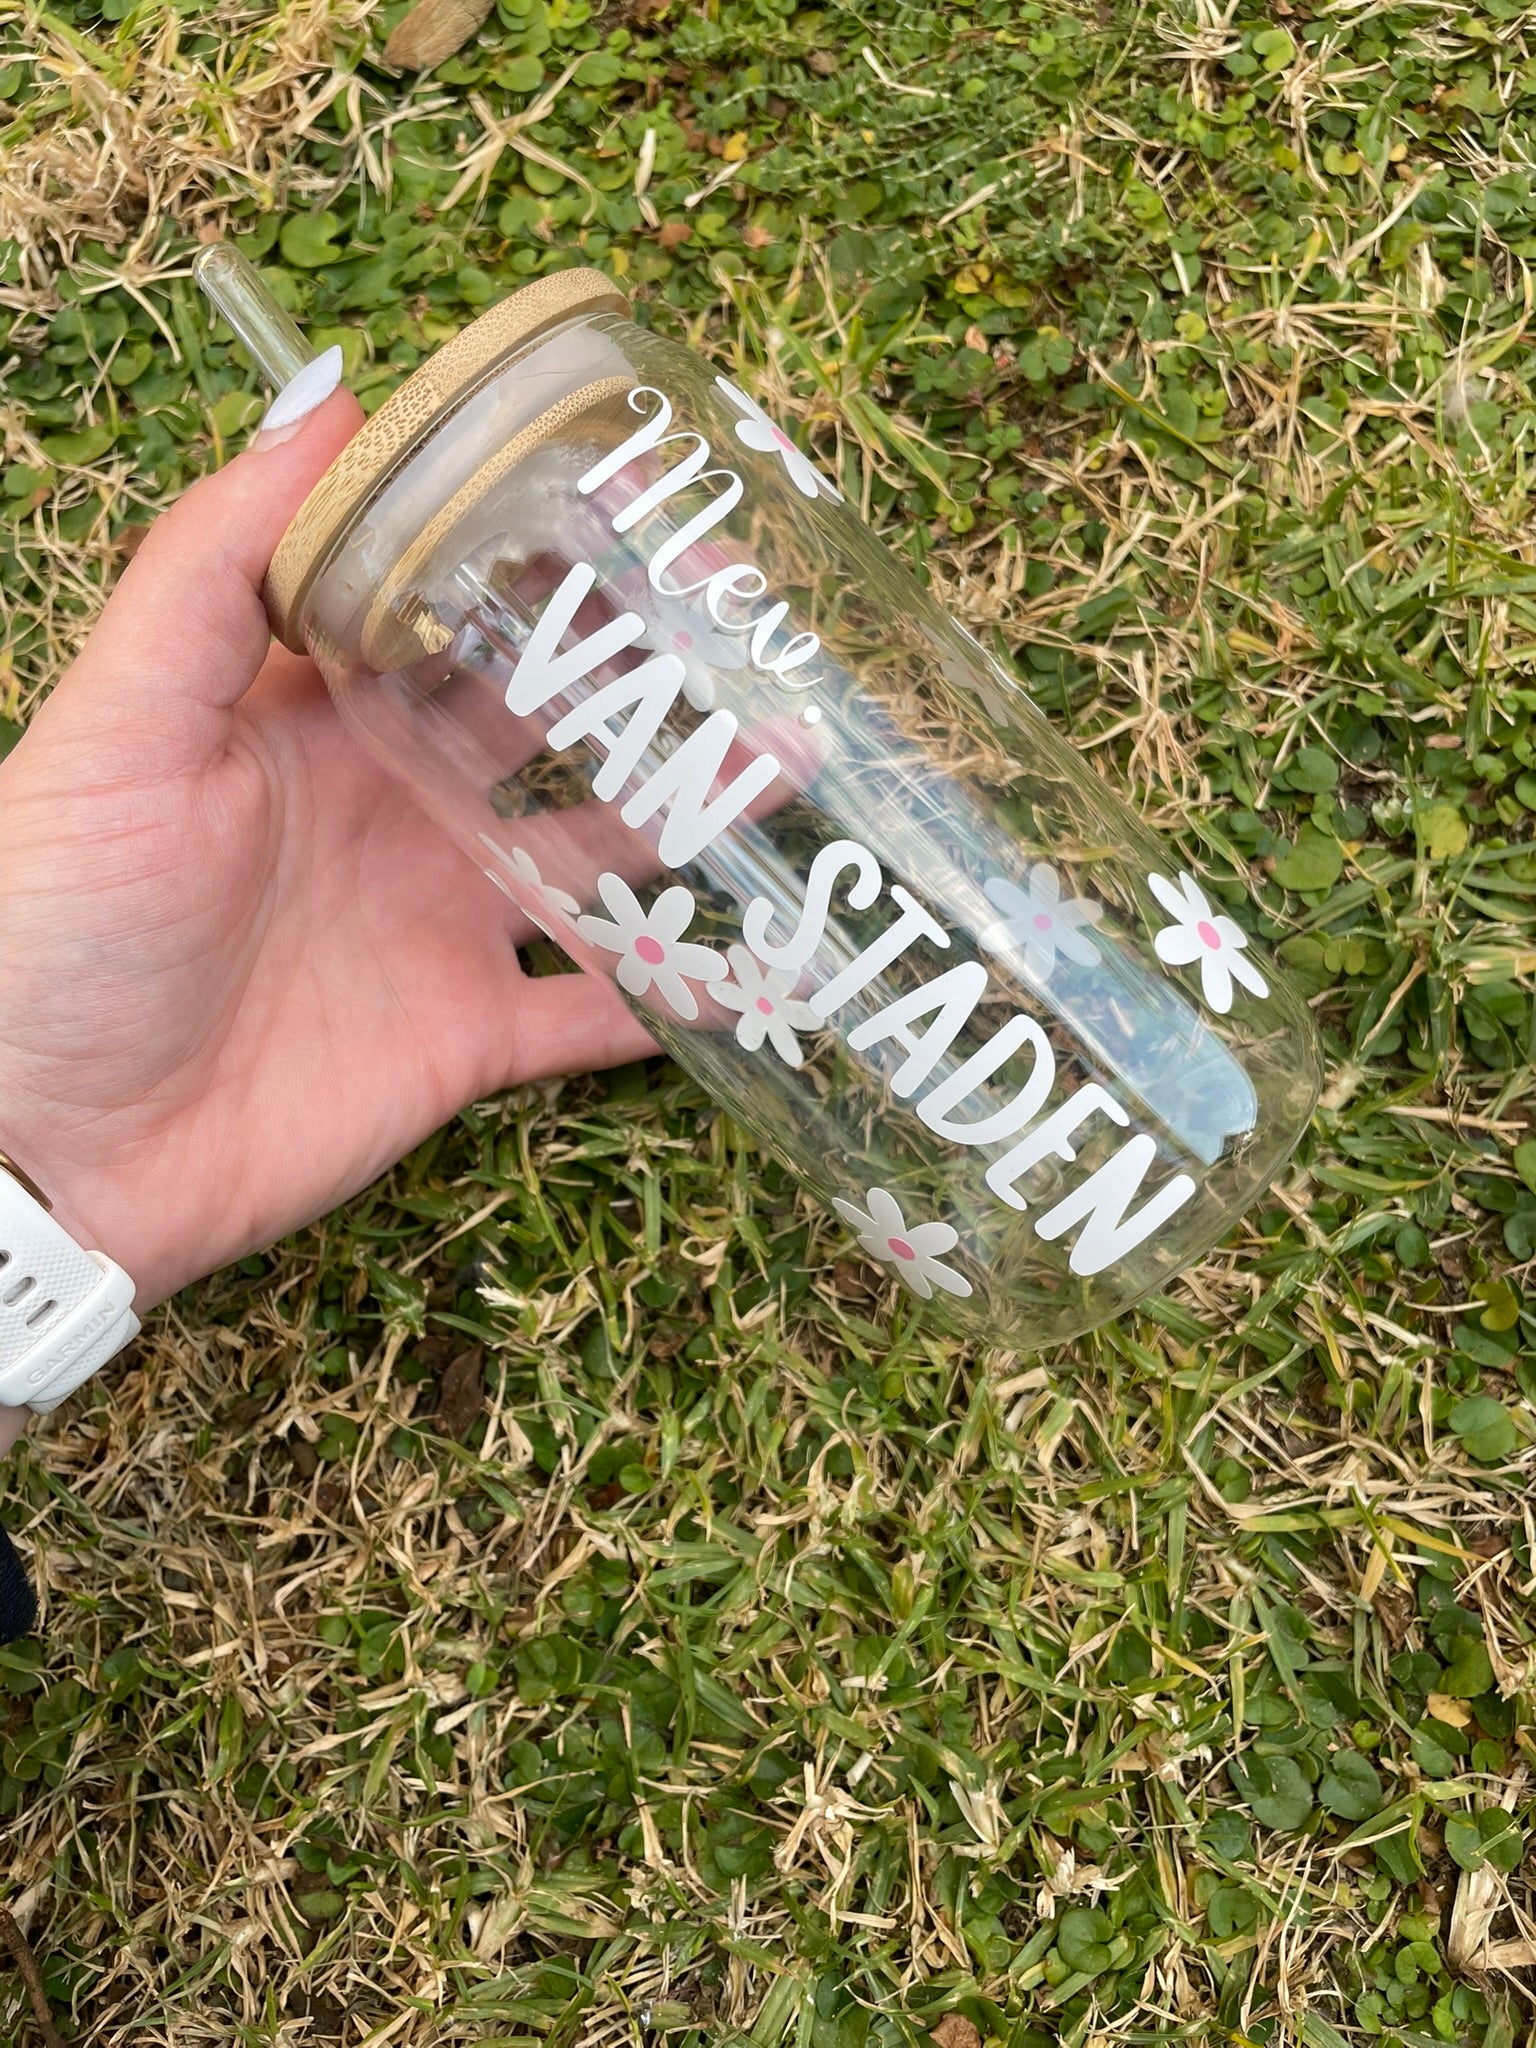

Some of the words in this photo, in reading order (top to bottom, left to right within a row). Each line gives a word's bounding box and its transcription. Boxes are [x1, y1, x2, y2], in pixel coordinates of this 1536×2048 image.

[505, 561, 782, 869] VAN
[743, 839, 1197, 1277] STADEN
[27, 1301, 118, 1386] GARMIN
